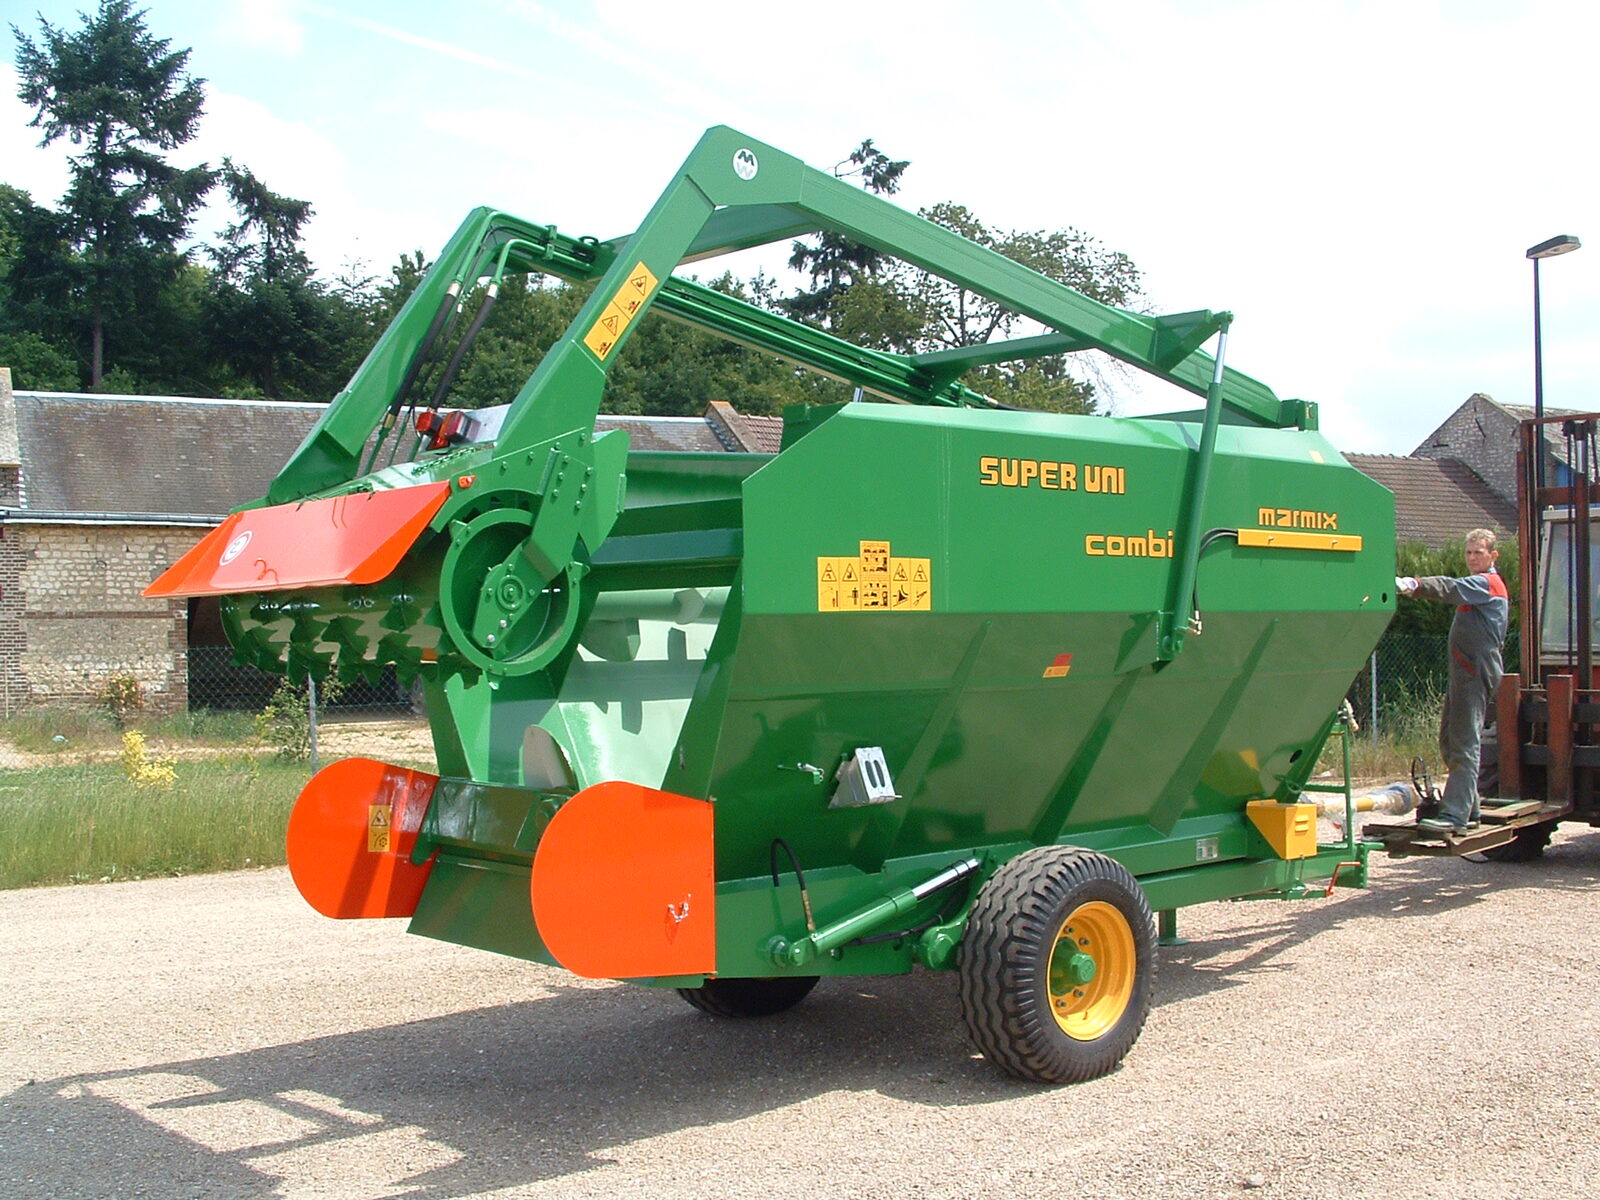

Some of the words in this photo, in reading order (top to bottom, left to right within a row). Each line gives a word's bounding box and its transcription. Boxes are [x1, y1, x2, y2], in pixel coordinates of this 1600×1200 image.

[980, 456, 1077, 491] SUPER
[1085, 465, 1125, 494] UNI
[1258, 507, 1338, 530] marmix
[1085, 530, 1174, 558] combi
